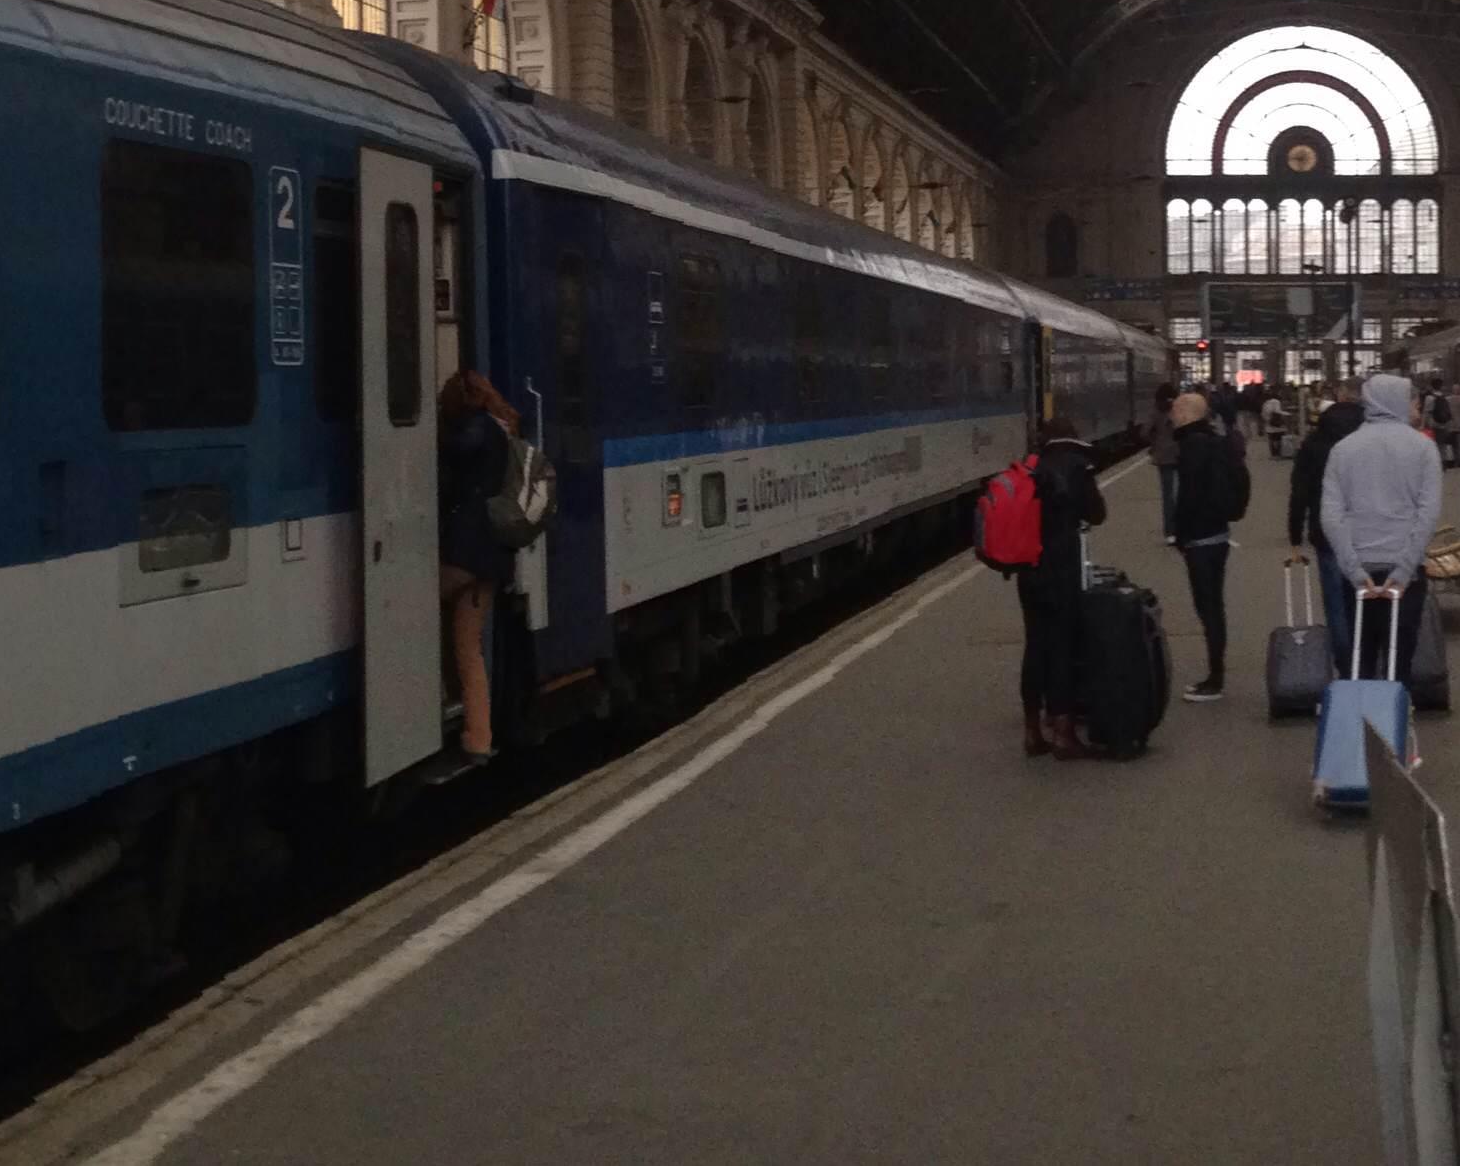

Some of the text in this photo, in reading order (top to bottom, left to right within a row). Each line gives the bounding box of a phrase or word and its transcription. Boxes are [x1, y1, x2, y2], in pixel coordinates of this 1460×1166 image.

[104, 97, 252, 153] COUCHETTE COACH
[277, 176, 295, 229] 2
